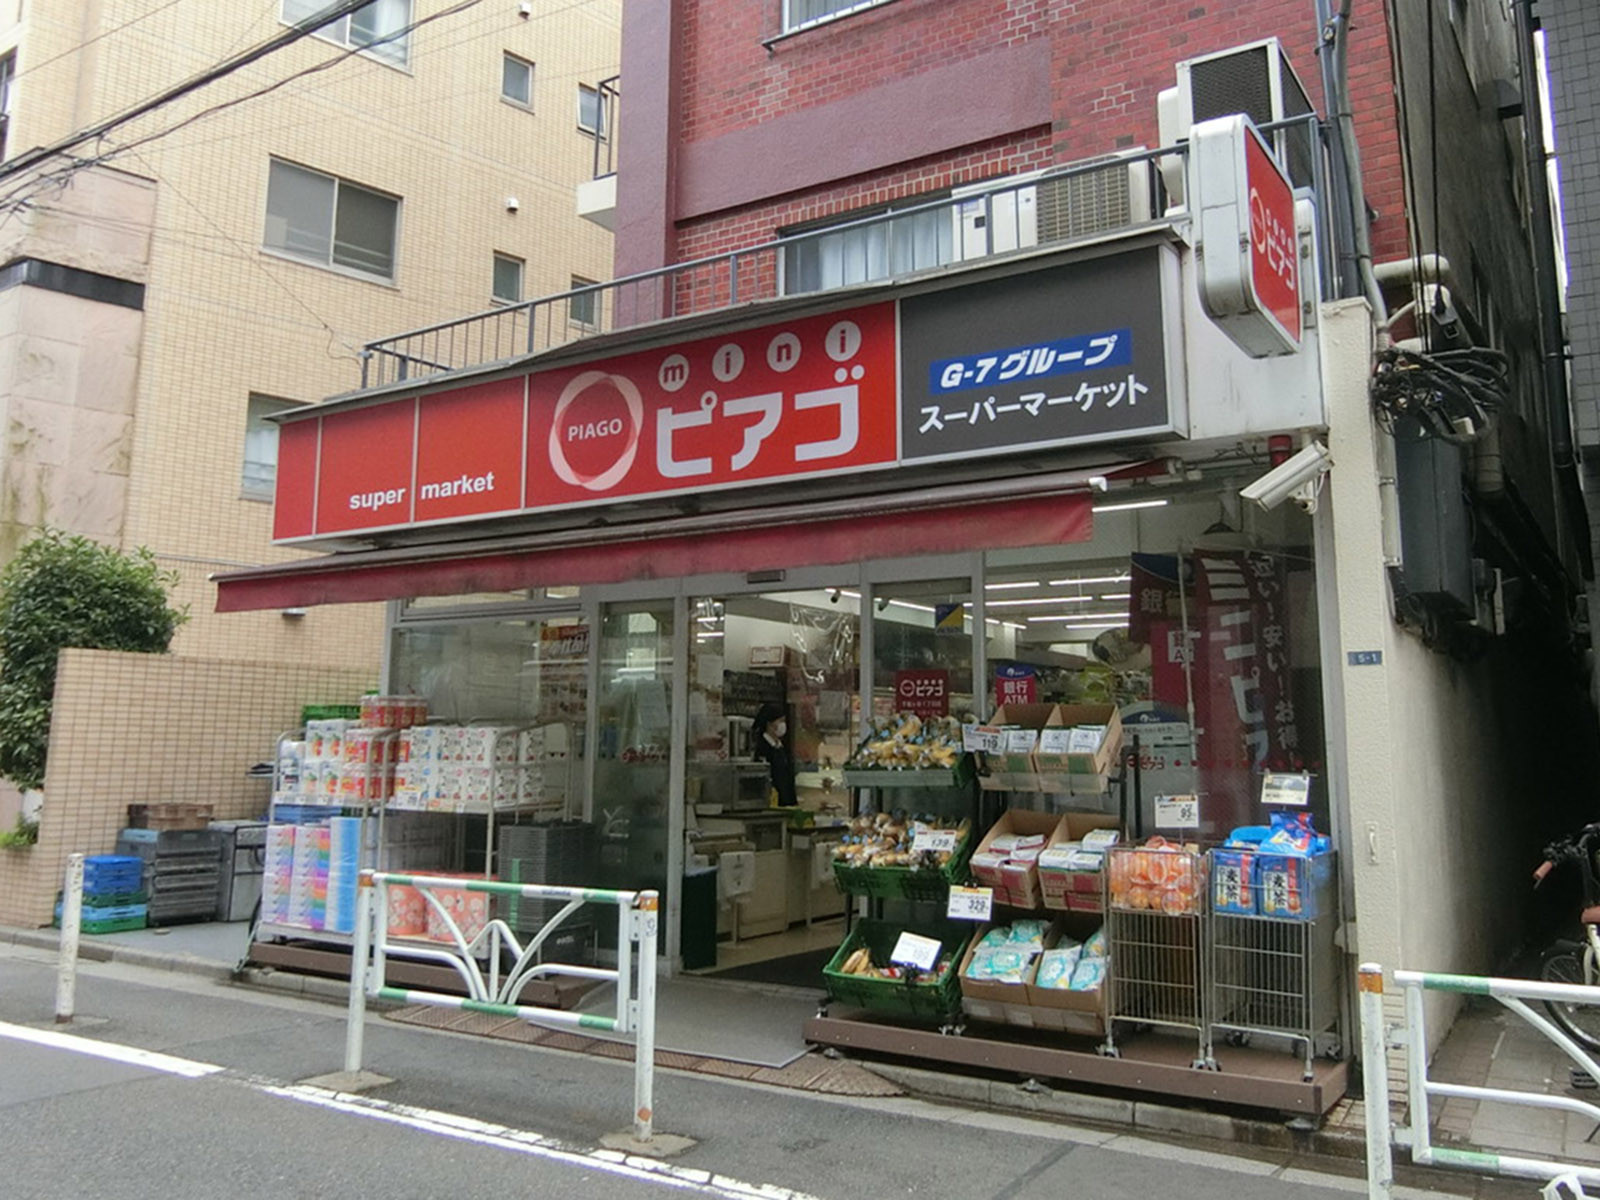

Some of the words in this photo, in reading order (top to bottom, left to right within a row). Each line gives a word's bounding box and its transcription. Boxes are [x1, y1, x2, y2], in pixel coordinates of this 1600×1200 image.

[662, 327, 849, 384] mini
[940, 334, 1118, 390] G-7グループ
[656, 364, 865, 478] ピアゴ
[919, 374, 1148, 434] スーパーマーケット
[567, 418, 623, 442] PIAGO
[349, 486, 405, 511] super
[421, 471, 494, 500] market
[1003, 681, 1028, 694] 銀行
[1004, 695, 1028, 704] ATM
